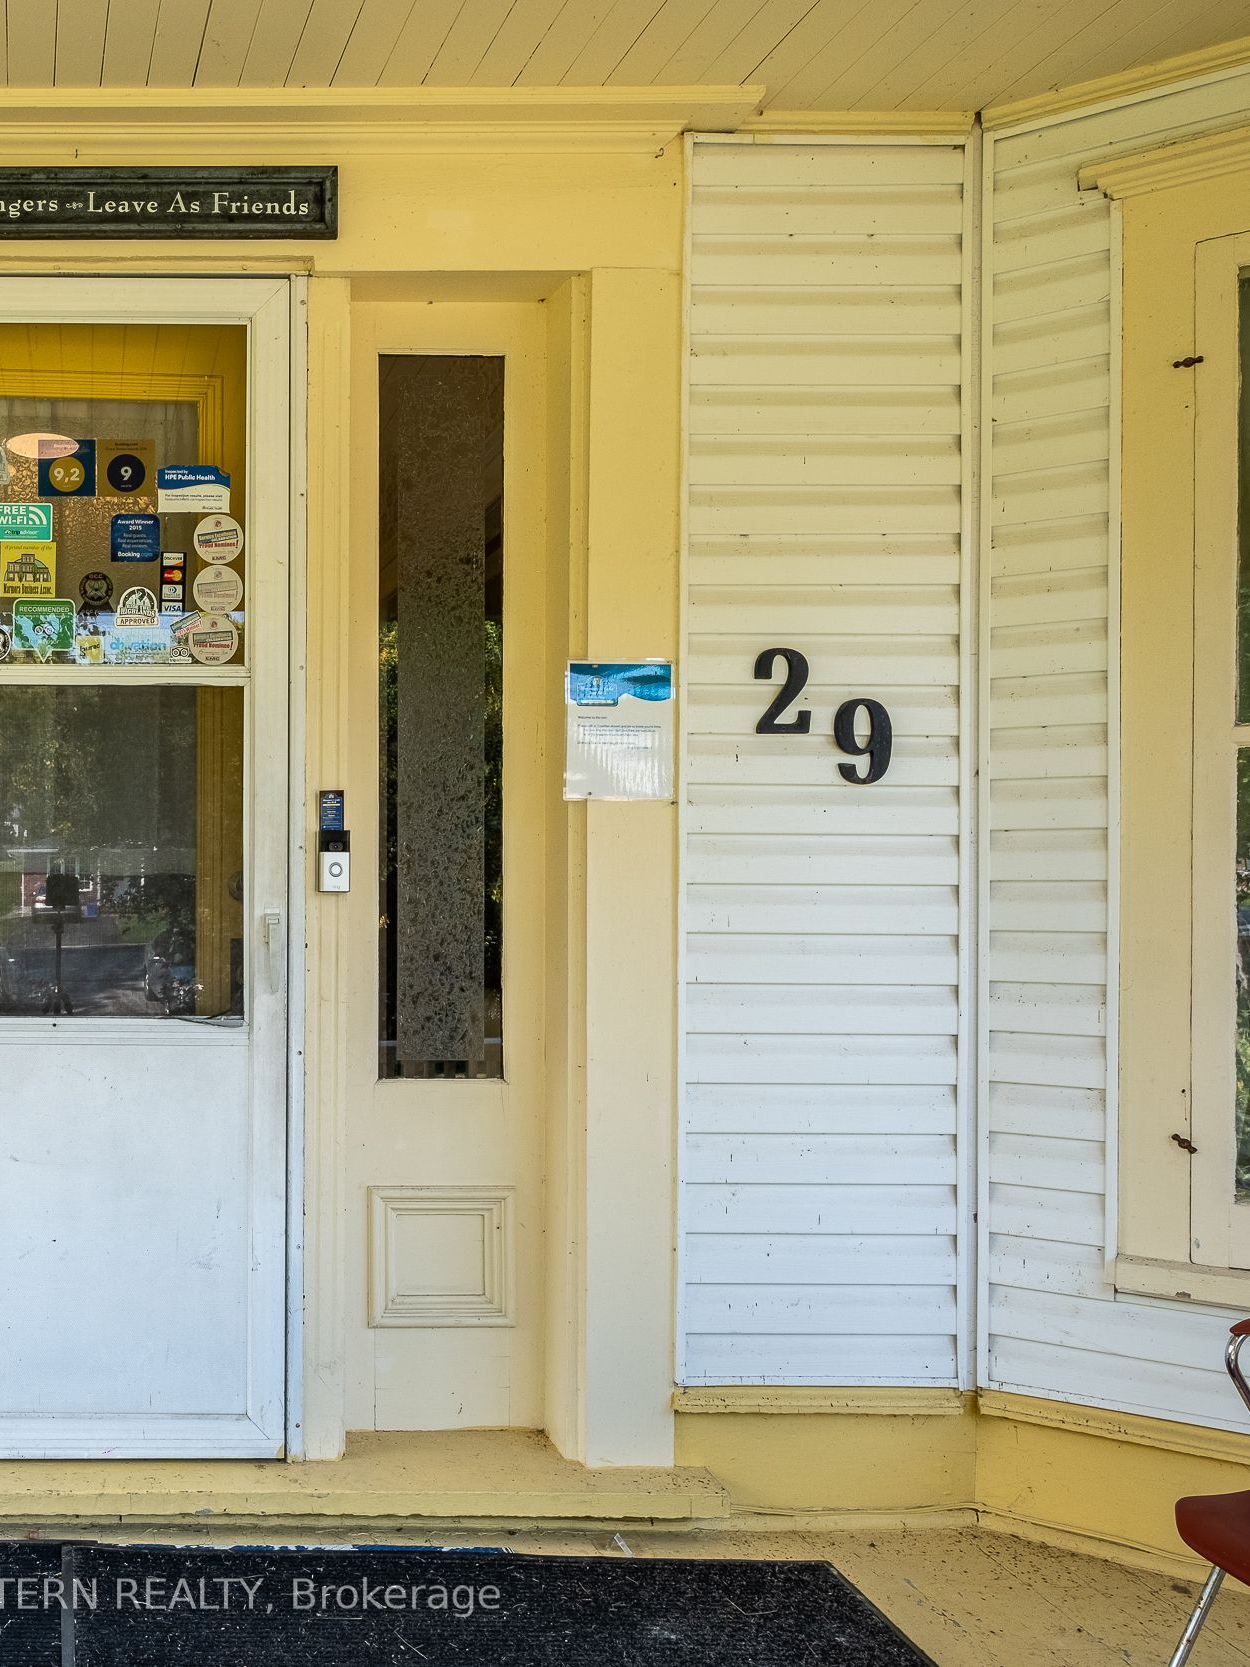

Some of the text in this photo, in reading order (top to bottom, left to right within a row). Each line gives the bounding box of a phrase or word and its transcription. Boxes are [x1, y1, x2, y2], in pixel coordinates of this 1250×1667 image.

[86, 191, 159, 214] Leave
[167, 191, 200, 214] As
[211, 190, 310, 216] Friends
[53, 467, 80, 483] 9,2
[120, 466, 132, 481] 9
[120, 617, 155, 625] APPROVED
